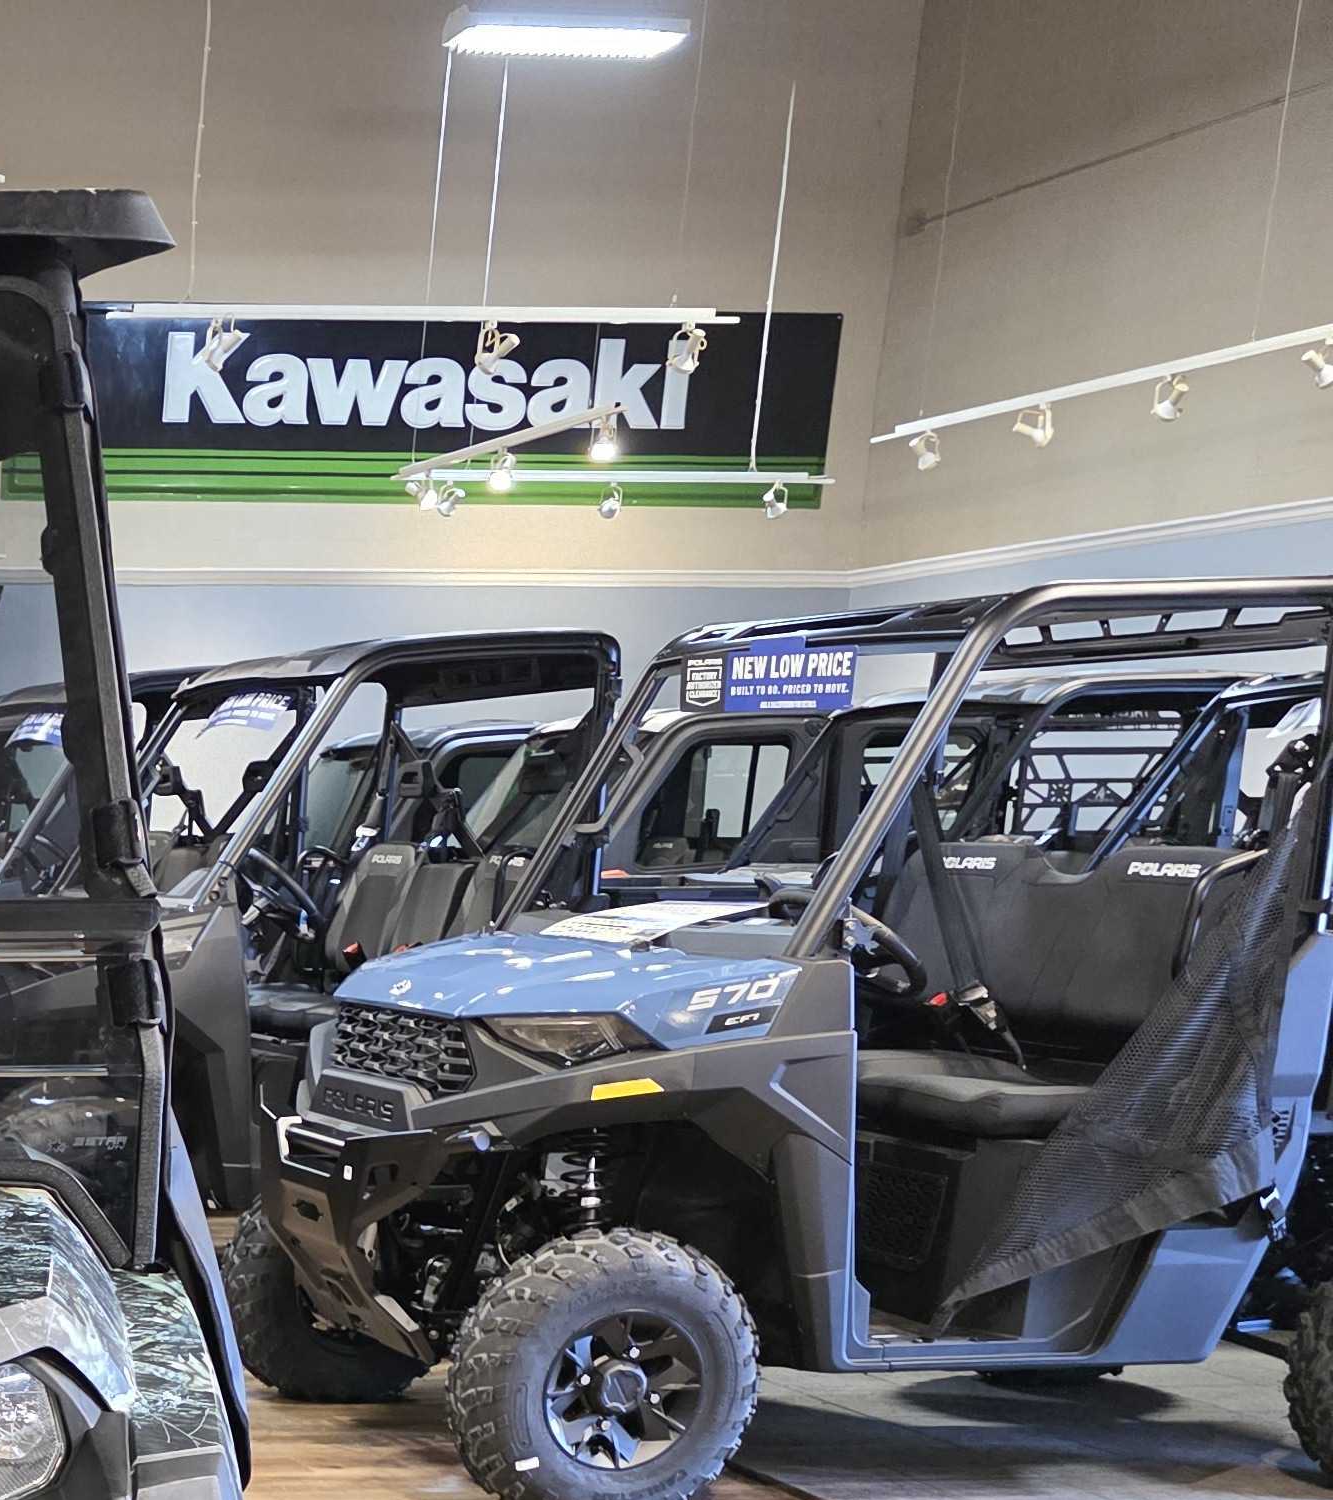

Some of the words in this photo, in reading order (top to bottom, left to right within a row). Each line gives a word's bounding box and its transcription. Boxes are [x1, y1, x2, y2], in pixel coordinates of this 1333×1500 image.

[162, 331, 690, 430] Kawasaki
[731, 655, 767, 680] NEW
[770, 653, 805, 679] LOW
[807, 651, 854, 678] PRICE
[253, 692, 292, 711] PRICE
[730, 685, 754, 697] BUILT
[756, 685, 766, 696] TO
[783, 684, 813, 695] PRICED
[814, 683, 824, 694] TO
[825, 682, 850, 693] MOVE.
[943, 856, 997, 870] OLARIS
[1127, 861, 1202, 878] POLARIS
[686, 977, 781, 1012] 570
[322, 1088, 394, 1123] POLARIS
